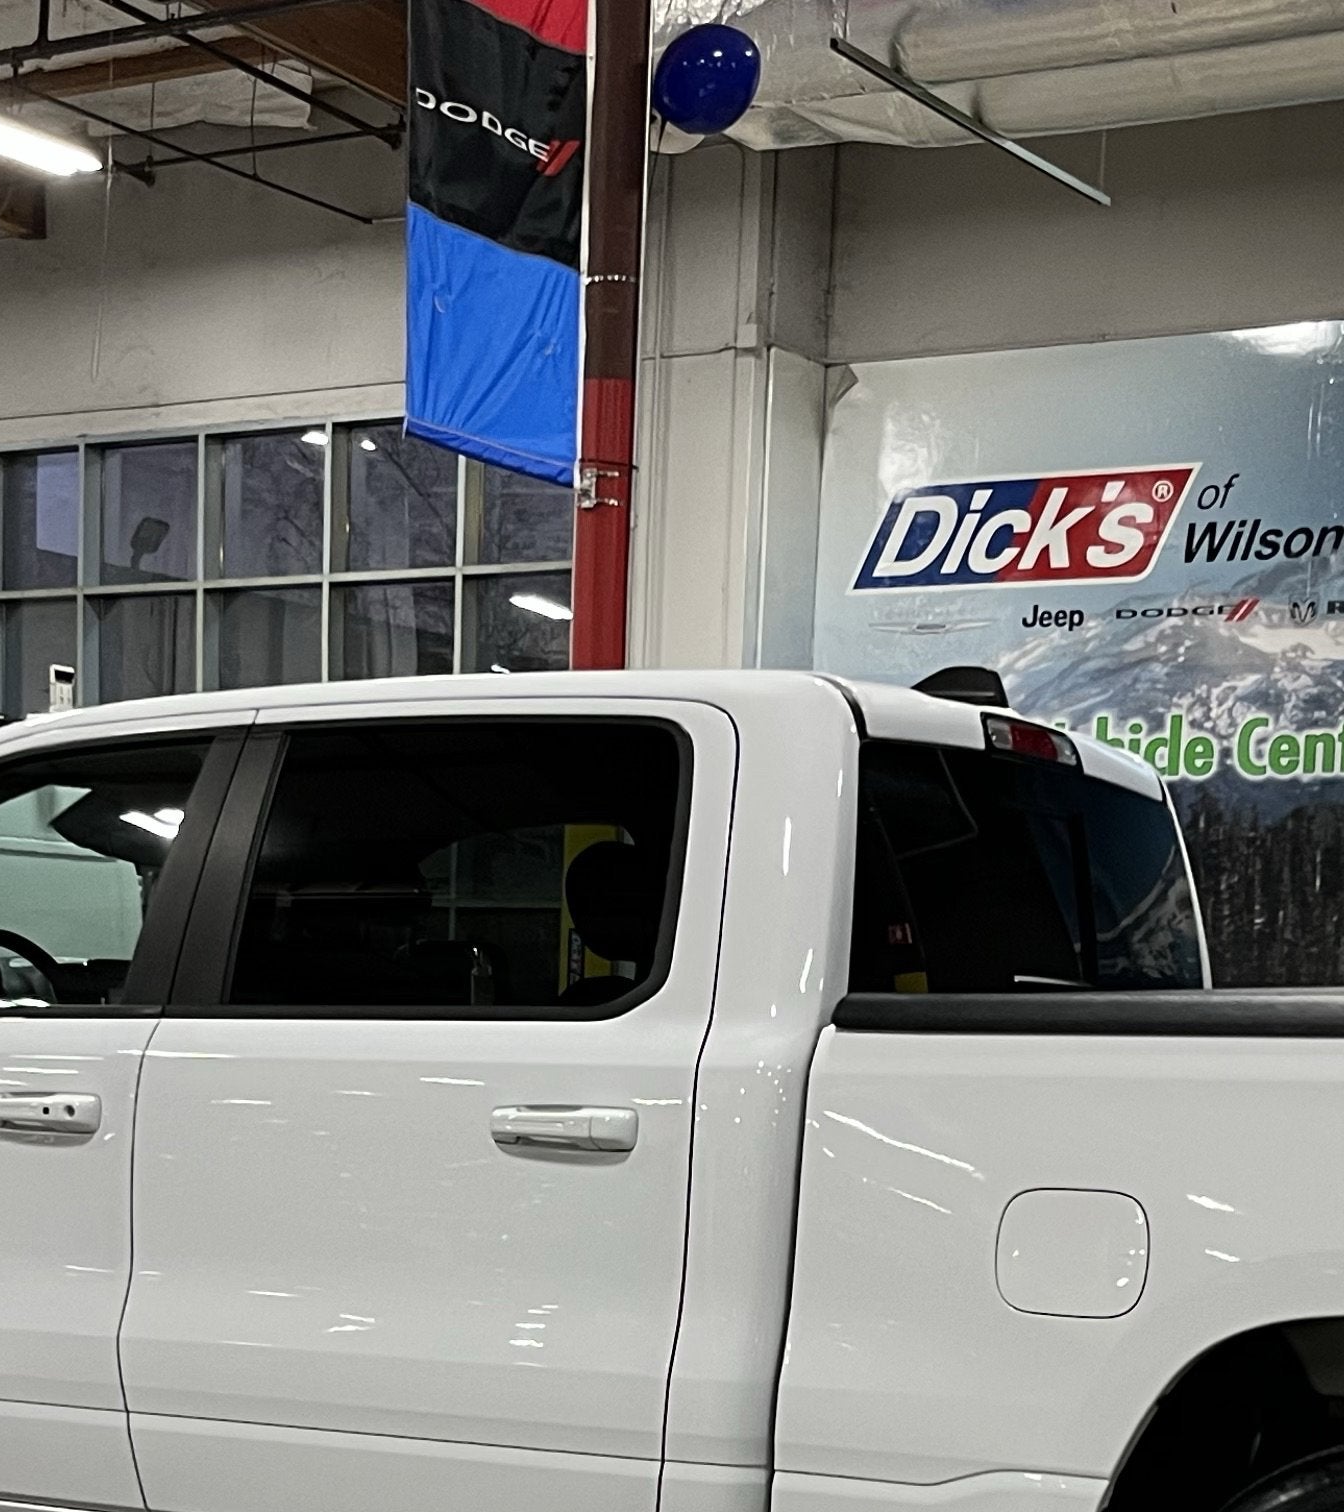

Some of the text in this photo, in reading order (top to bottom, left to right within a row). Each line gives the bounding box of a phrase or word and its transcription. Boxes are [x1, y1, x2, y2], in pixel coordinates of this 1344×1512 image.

[415, 87, 551, 163] DODGE
[872, 474, 1240, 577] Dick's of
[1022, 605, 1084, 631] Jeep
[1115, 604, 1239, 619] DODGE
